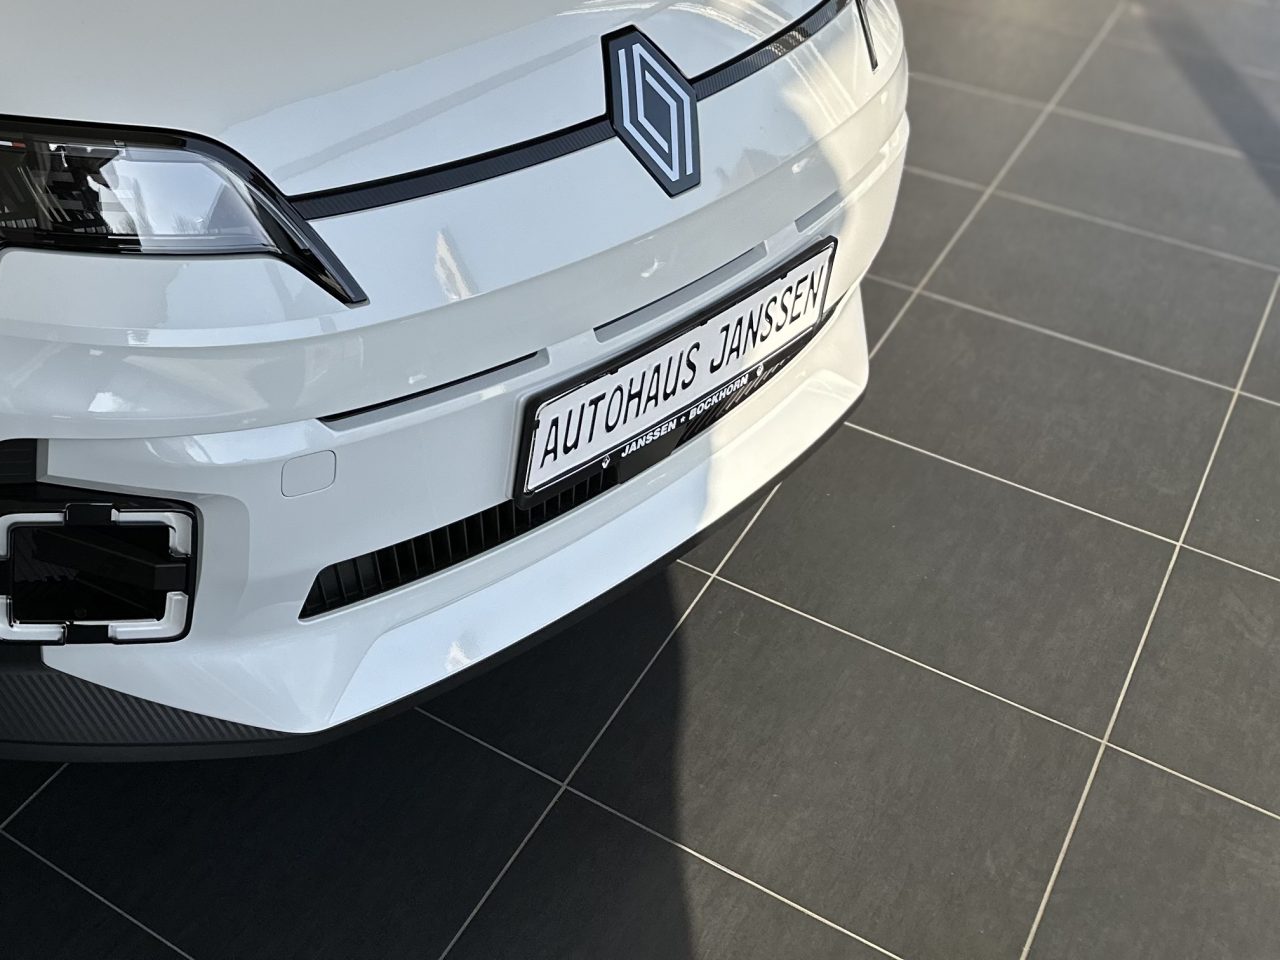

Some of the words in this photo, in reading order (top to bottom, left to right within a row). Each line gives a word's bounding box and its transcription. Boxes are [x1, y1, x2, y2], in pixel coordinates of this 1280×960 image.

[540, 341, 701, 469] AUTOHAUS
[709, 264, 826, 374] JANSSEN
[620, 418, 678, 458] JANSSEN
[688, 373, 751, 418] BOCKHORN
